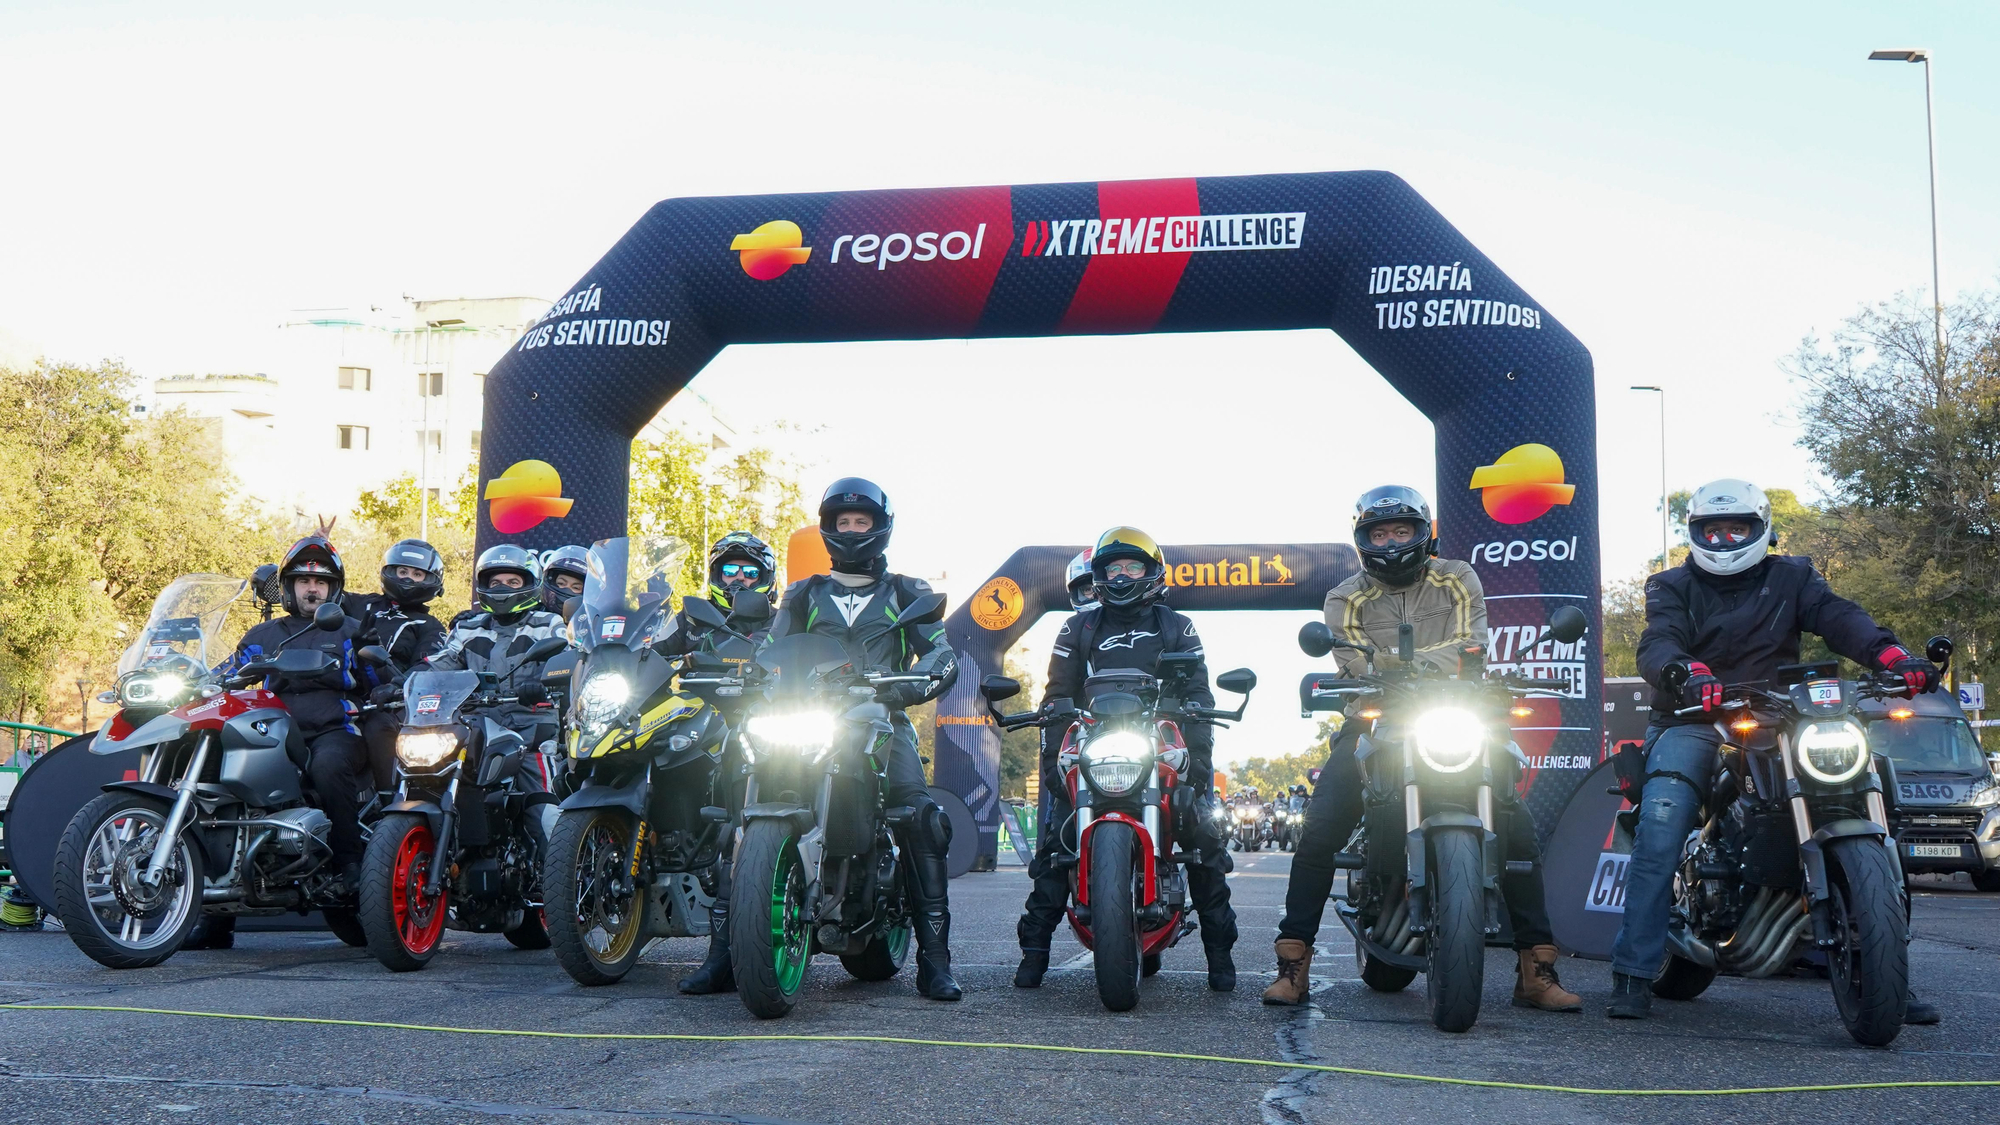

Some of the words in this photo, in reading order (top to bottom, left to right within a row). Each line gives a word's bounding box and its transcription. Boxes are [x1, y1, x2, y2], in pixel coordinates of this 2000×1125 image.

[830, 222, 987, 271] repsol
[1045, 216, 1166, 257] XTREME
[1171, 216, 1297, 249] CHALLENGE
[1368, 261, 1473, 295] ¡DESAFÍA
[1375, 301, 1418, 329] TUS
[1422, 299, 1542, 330] SENTIDOS!
[518, 324, 554, 352] TUS
[553, 319, 671, 347] SENTIDOS!
[1470, 535, 1578, 568] repsol
[1164, 556, 1263, 587] nental
[977, 579, 1018, 598] CONTINENTAL
[976, 614, 998, 628] SINCE
[999, 615, 1014, 627] 1871
[420, 701, 438, 709] 5524
[1819, 689, 1832, 699] 20
[936, 714, 986, 728] Continental
[1900, 784, 1955, 800] SAGO
[1916, 846, 1939, 856] 5198
[1941, 846, 1958, 856] KDT
[1592, 859, 1632, 908] CH
